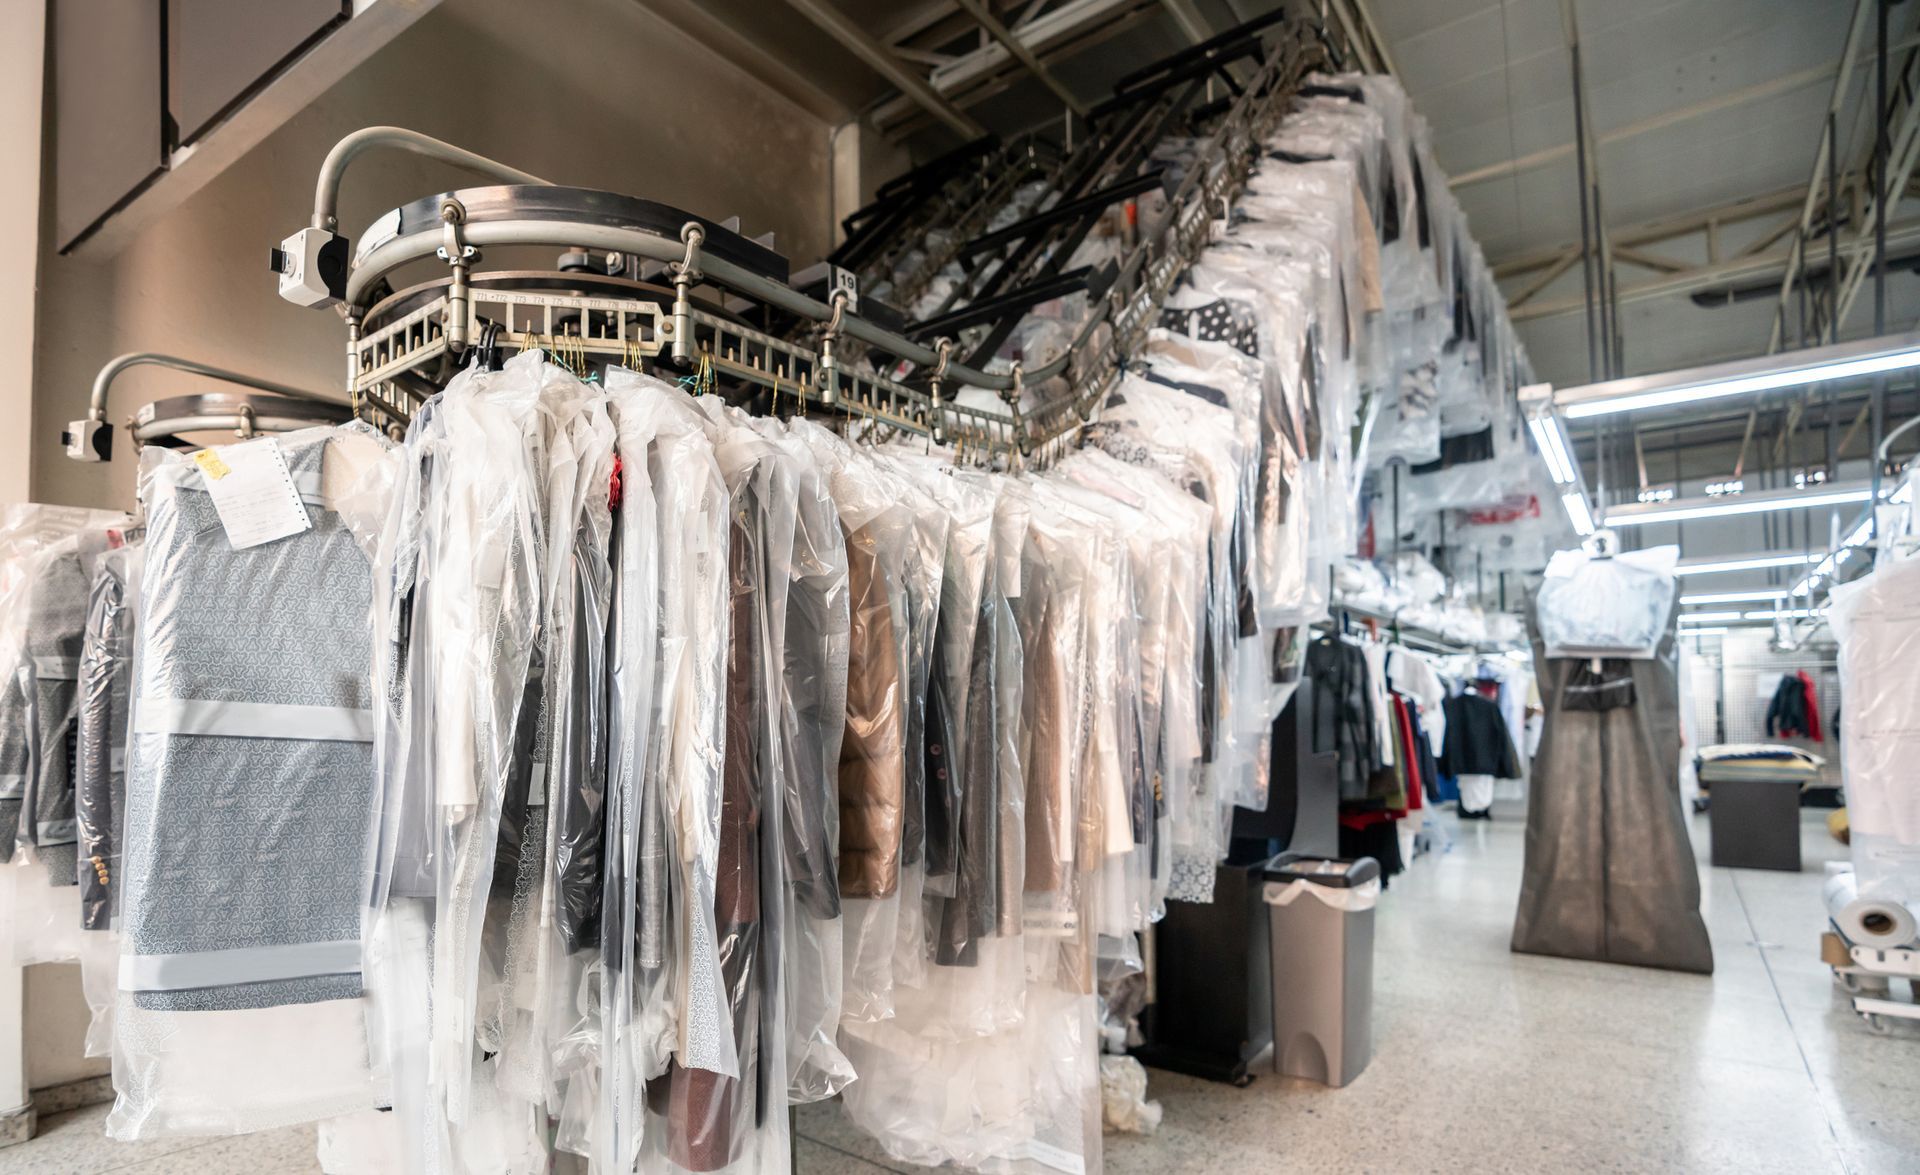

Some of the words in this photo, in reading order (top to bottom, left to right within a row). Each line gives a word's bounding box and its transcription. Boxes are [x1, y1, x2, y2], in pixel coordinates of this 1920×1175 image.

[841, 274, 854, 289] 19
[496, 294, 507, 302] 772
[515, 295, 527, 304] 773
[534, 296, 545, 304] 774
